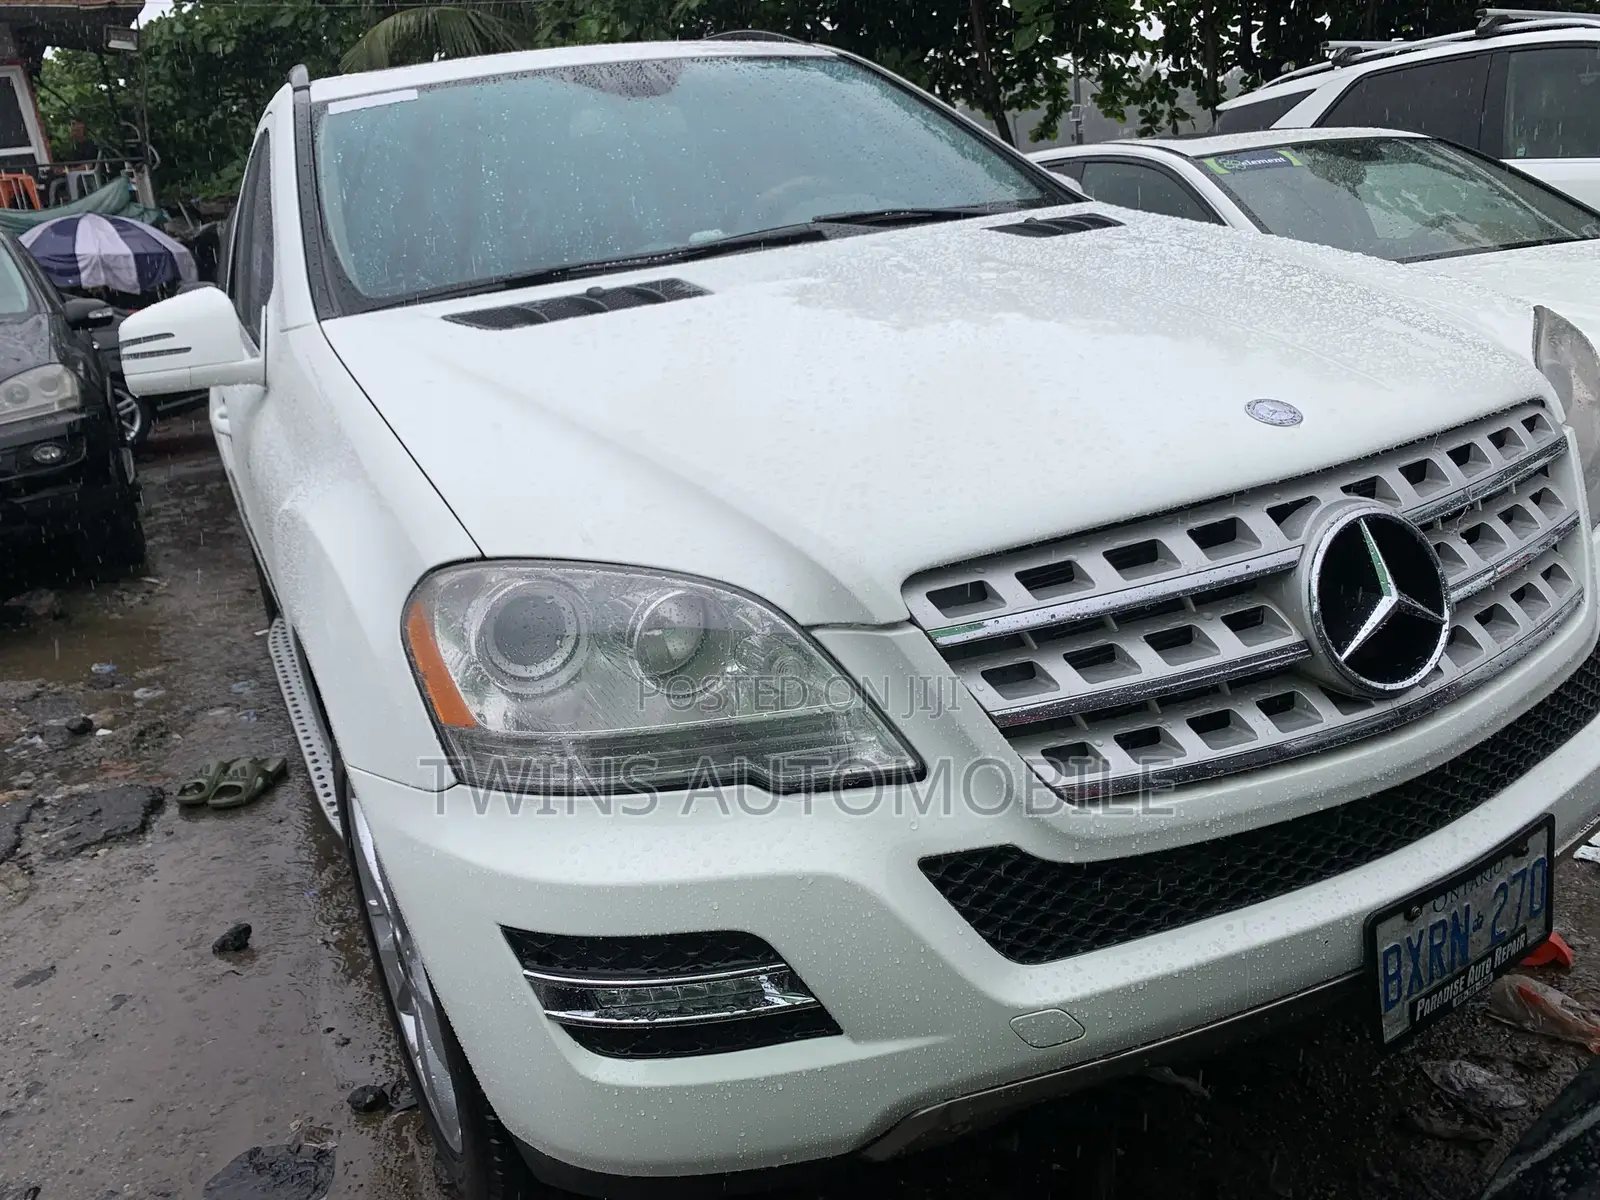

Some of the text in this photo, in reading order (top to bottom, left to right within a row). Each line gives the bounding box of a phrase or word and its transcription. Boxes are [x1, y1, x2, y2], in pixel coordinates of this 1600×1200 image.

[1383, 857, 1547, 1012] BXRN 270
[1416, 975, 1465, 1021] PARADISE
[1466, 957, 1492, 987] AUTO
[1494, 932, 1526, 968] REPAIR
